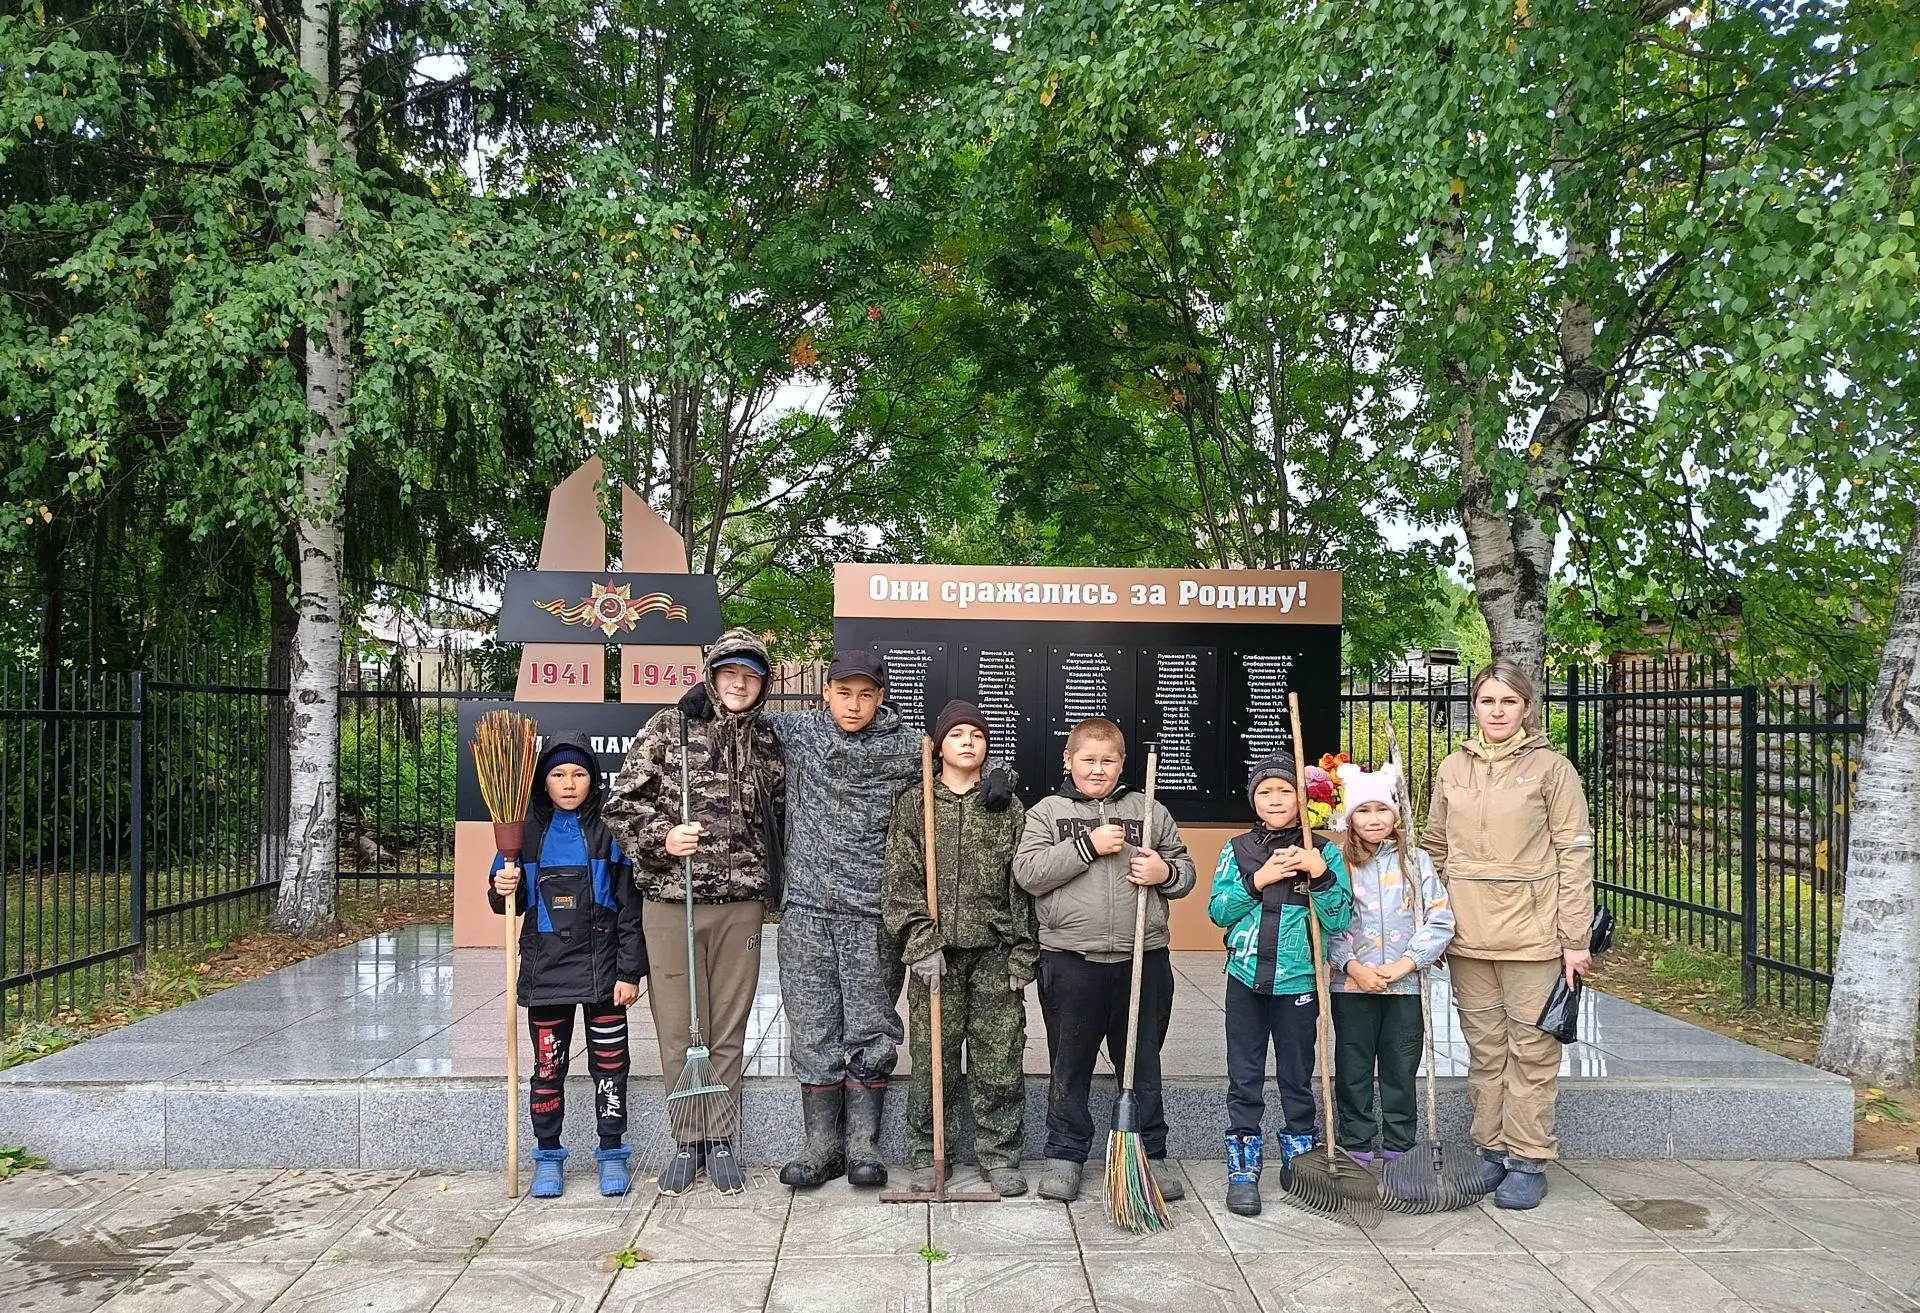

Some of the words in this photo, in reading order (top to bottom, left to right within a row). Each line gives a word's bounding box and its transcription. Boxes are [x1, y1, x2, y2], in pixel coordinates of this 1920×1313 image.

[868, 574, 928, 601] Они
[941, 580, 1118, 608] сражались
[1130, 584, 1166, 605] за
[1178, 580, 1308, 614] Родину!
[530, 662, 590, 686] 1941
[632, 663, 698, 687] 1945
